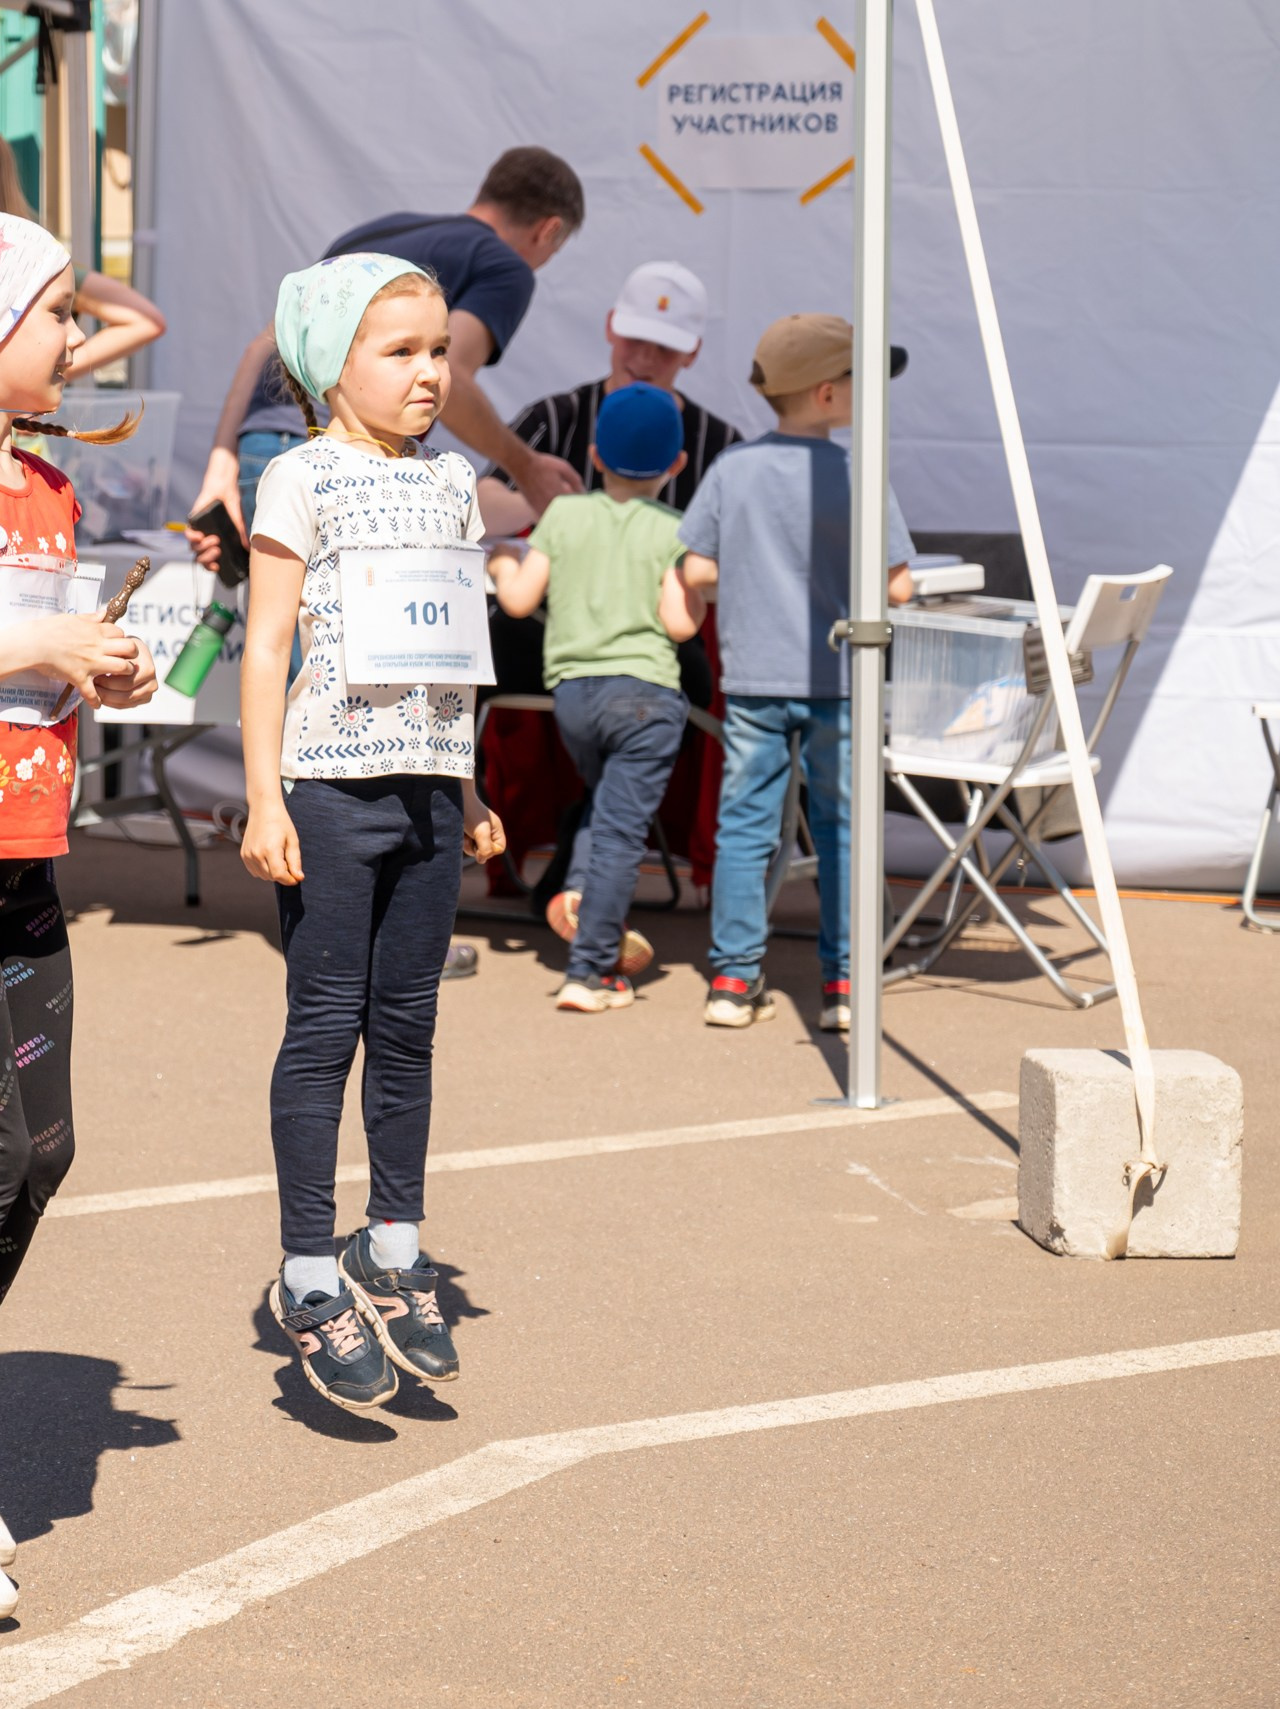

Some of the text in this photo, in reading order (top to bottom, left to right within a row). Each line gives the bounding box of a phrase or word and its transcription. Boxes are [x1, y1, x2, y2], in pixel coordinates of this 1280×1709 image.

[668, 82, 843, 106] РЕГИСТРАЦИЯ
[672, 113, 839, 135] УЧАСТНИКОВ
[403, 601, 450, 626] 101
[4, 967, 36, 989] UNICO
[16, 1040, 56, 1069] UNICORN
